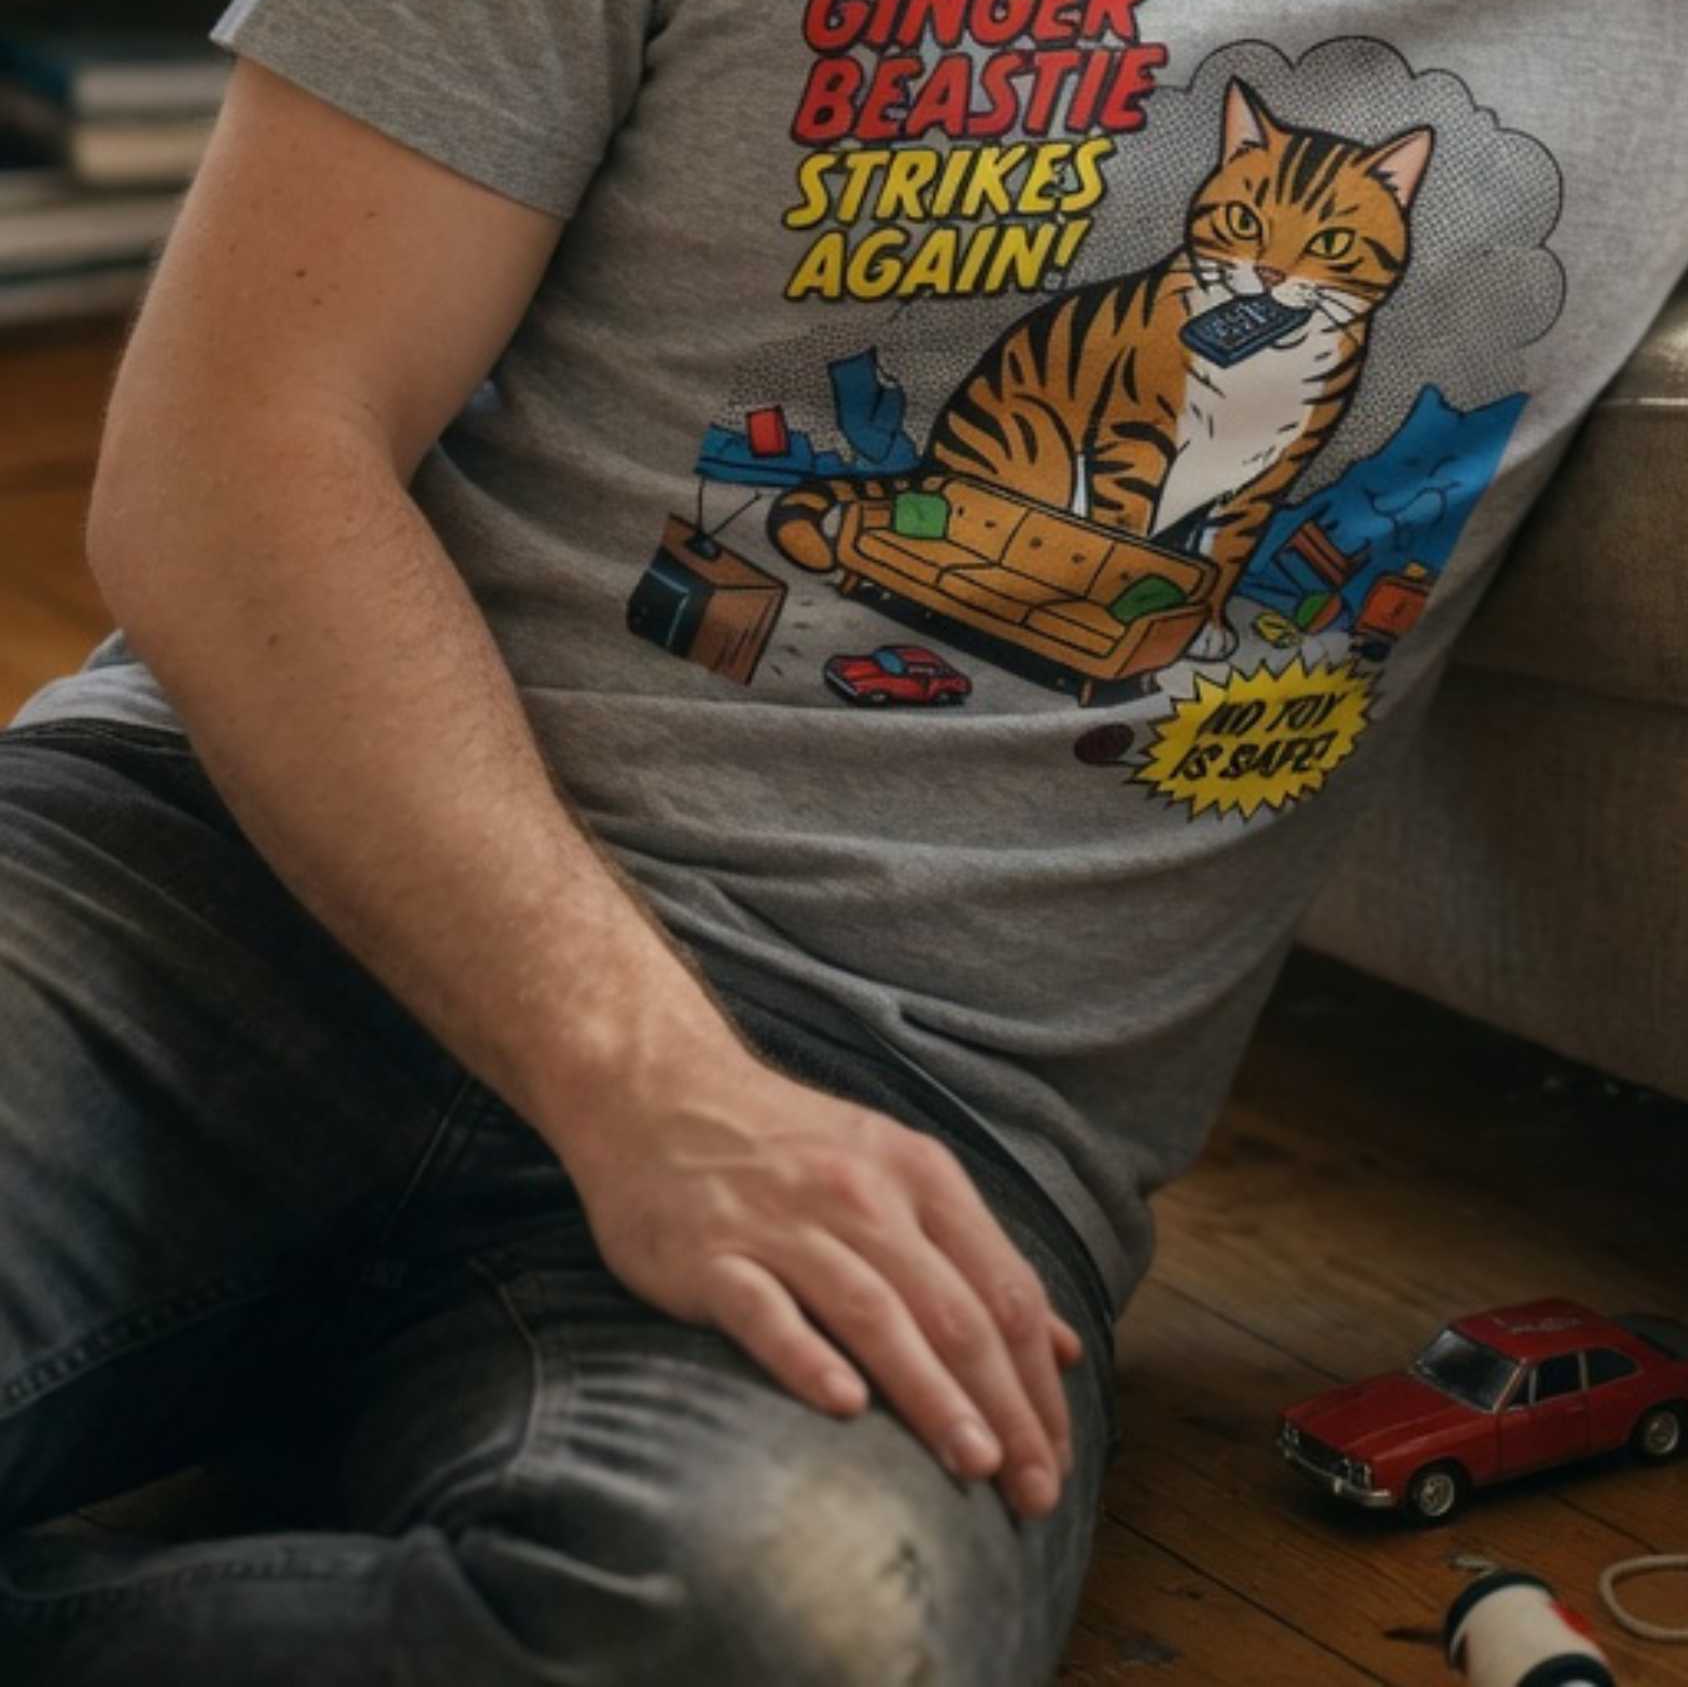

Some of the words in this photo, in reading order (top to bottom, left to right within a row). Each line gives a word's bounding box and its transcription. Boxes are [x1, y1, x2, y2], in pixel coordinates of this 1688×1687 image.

[790, 43, 1168, 144] BEASTIE
[782, 136, 1116, 230] STRIKES
[784, 216, 1091, 301] AGAIN!
[1200, 700, 1267, 736] NO
[1266, 692, 1348, 732] TOY
[1169, 743, 1223, 780] IS
